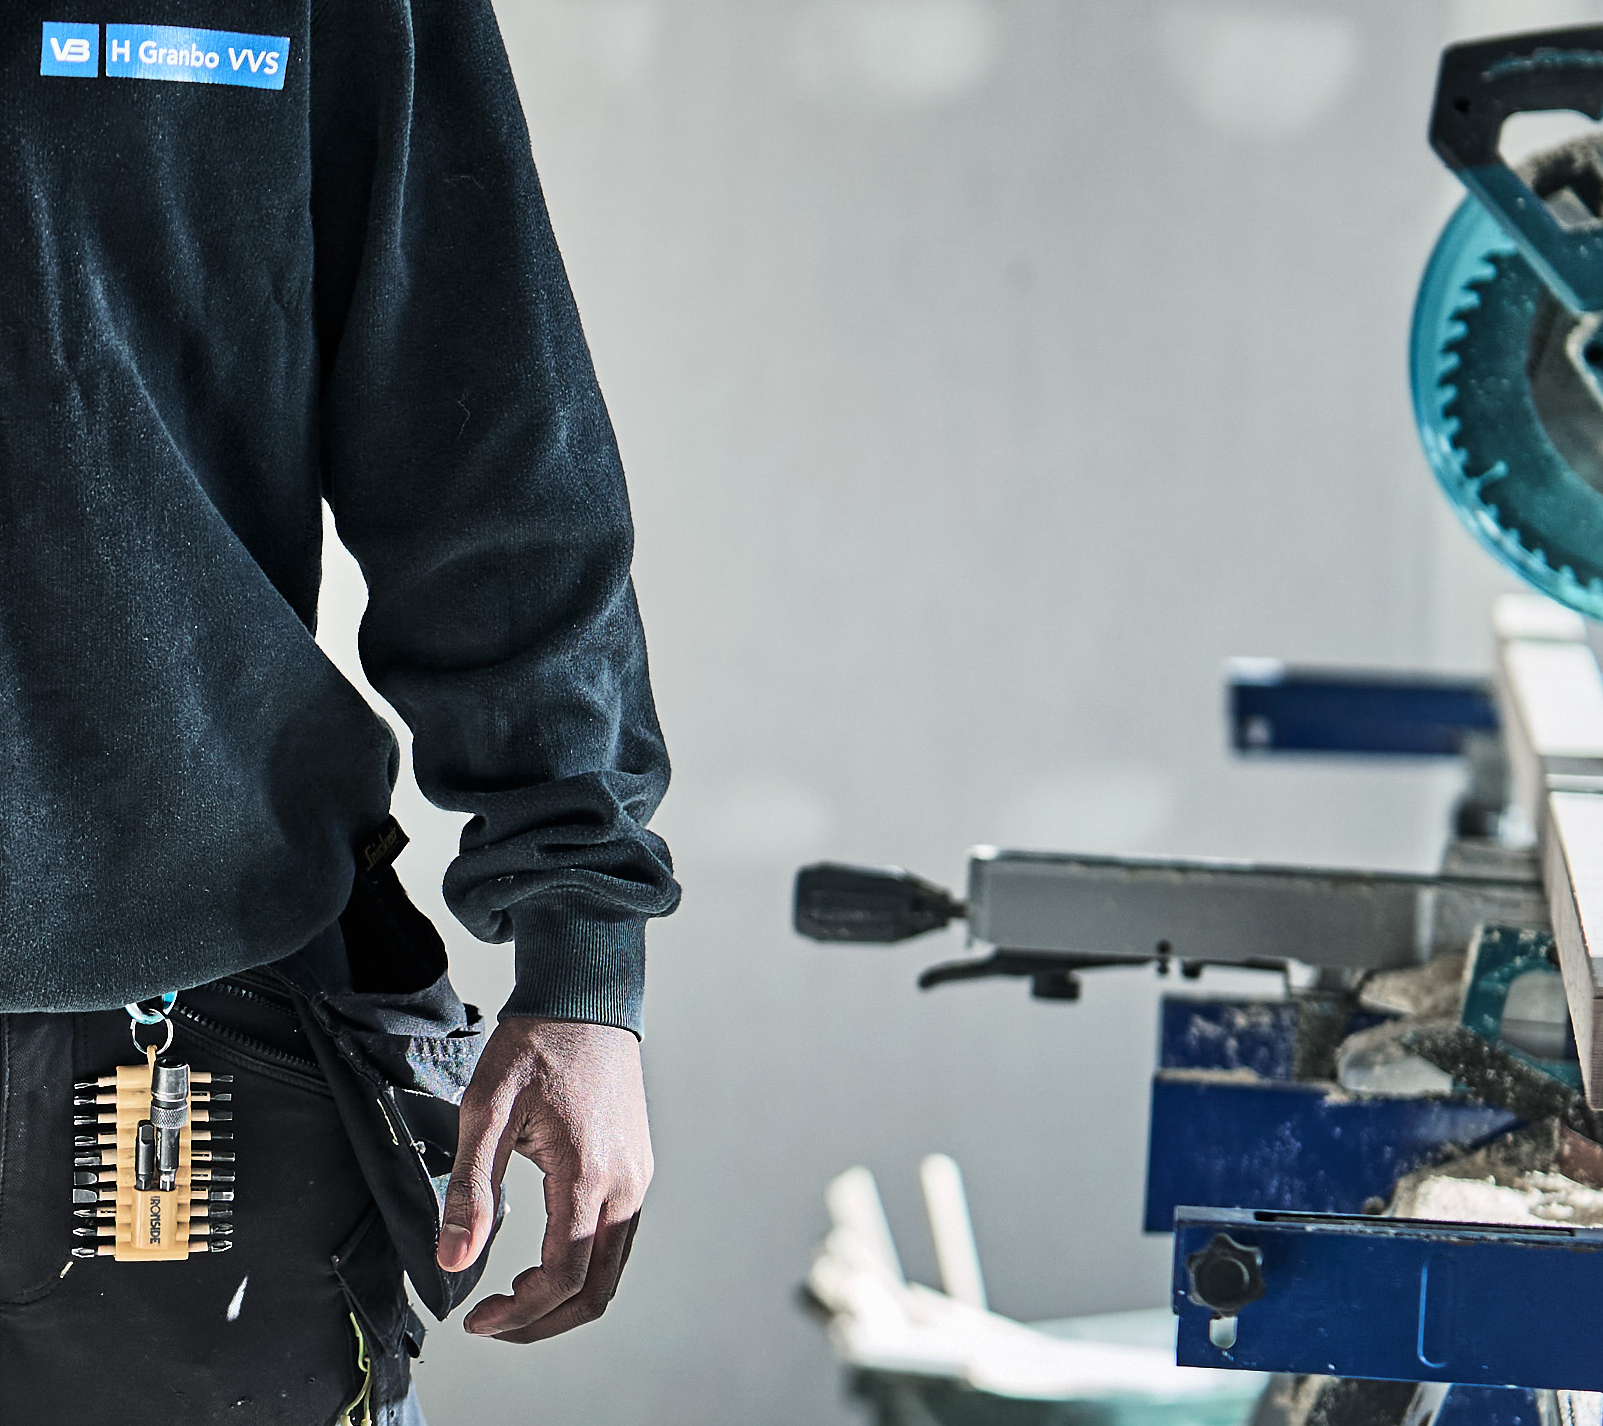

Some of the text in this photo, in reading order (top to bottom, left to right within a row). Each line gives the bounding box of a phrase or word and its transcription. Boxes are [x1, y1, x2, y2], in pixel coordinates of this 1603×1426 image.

[111, 39, 130, 63] H
[138, 41, 220, 68] Granbo
[228, 47, 279, 75] VVS
[150, 1196, 161, 1245] IRONSIDE
